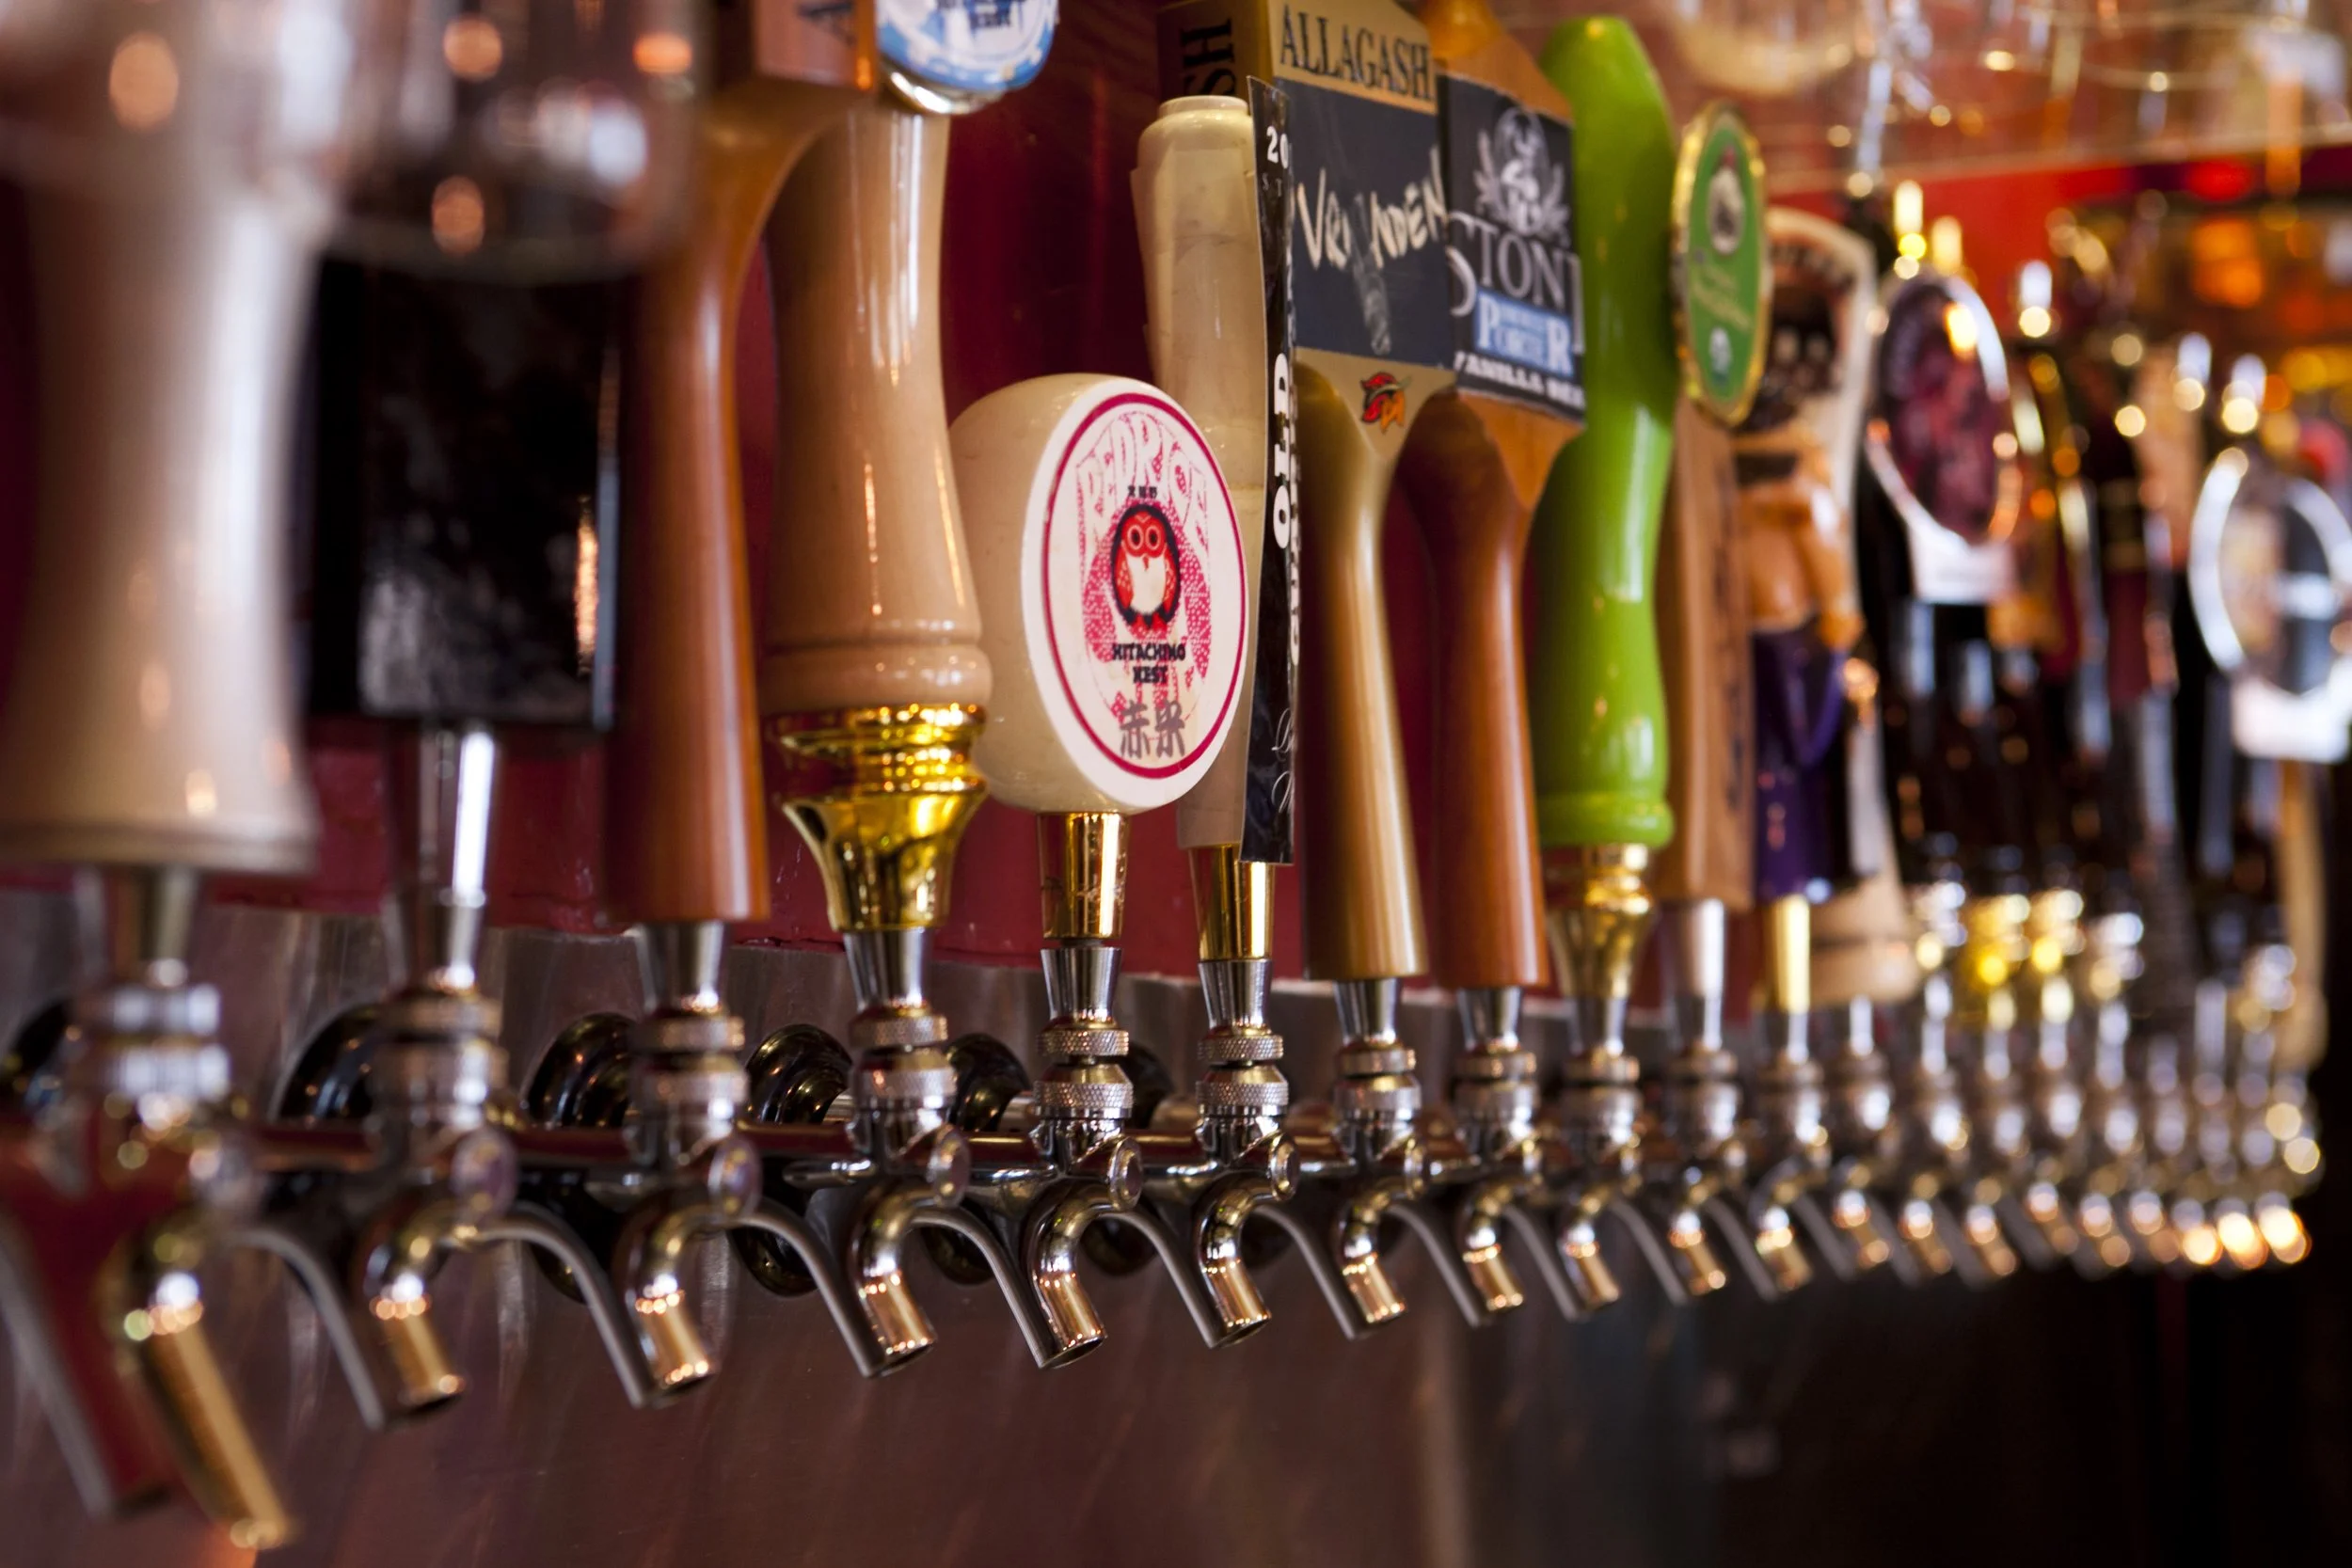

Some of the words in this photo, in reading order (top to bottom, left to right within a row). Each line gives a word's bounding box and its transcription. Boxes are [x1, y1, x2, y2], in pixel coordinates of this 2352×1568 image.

[1280, 4, 1431, 101] ALLAGASH
[1112, 642, 1185, 661] HITACHINO
[1133, 665, 1168, 684] NEST
